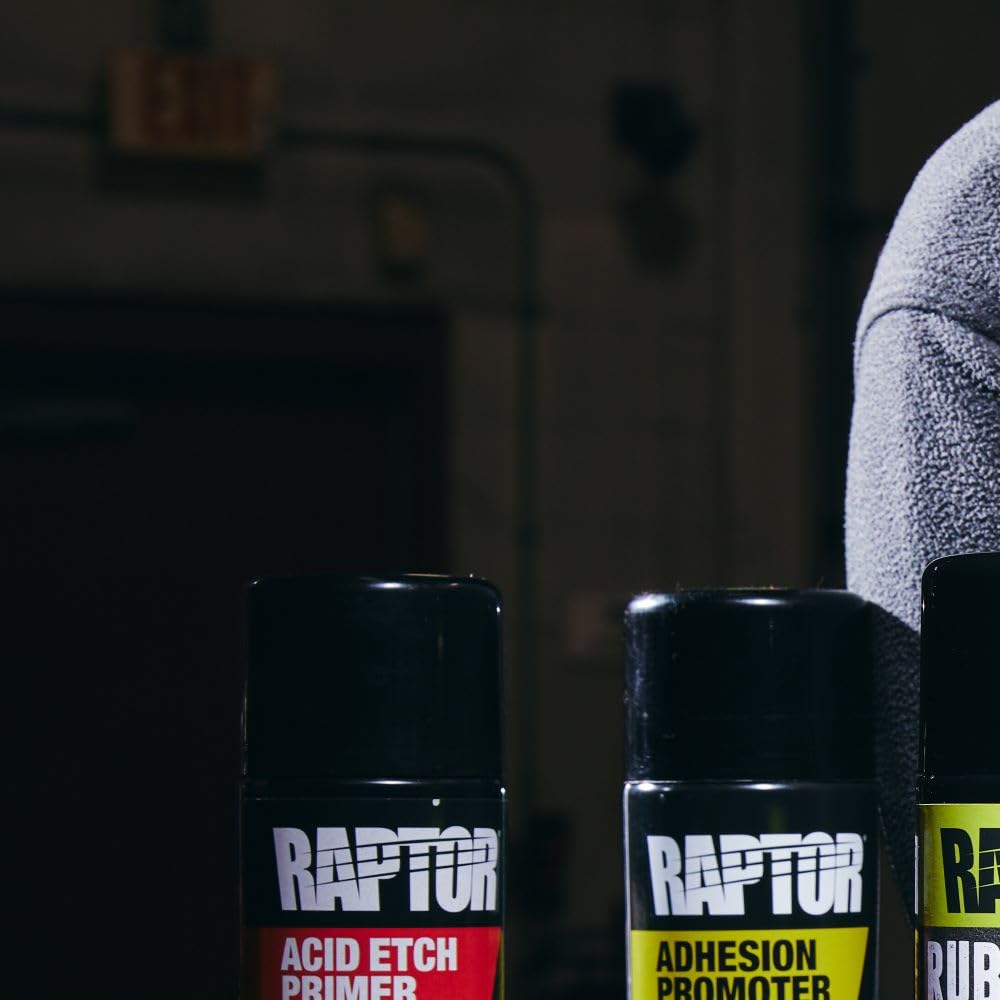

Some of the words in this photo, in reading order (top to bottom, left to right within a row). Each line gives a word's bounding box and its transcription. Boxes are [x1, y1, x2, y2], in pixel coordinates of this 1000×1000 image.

[272, 825, 498, 913] RAPTOR
[646, 831, 865, 917] RAPTOR
[280, 936, 361, 972] ACID
[369, 936, 458, 972] ETCH
[656, 939, 817, 972] ADHESION
